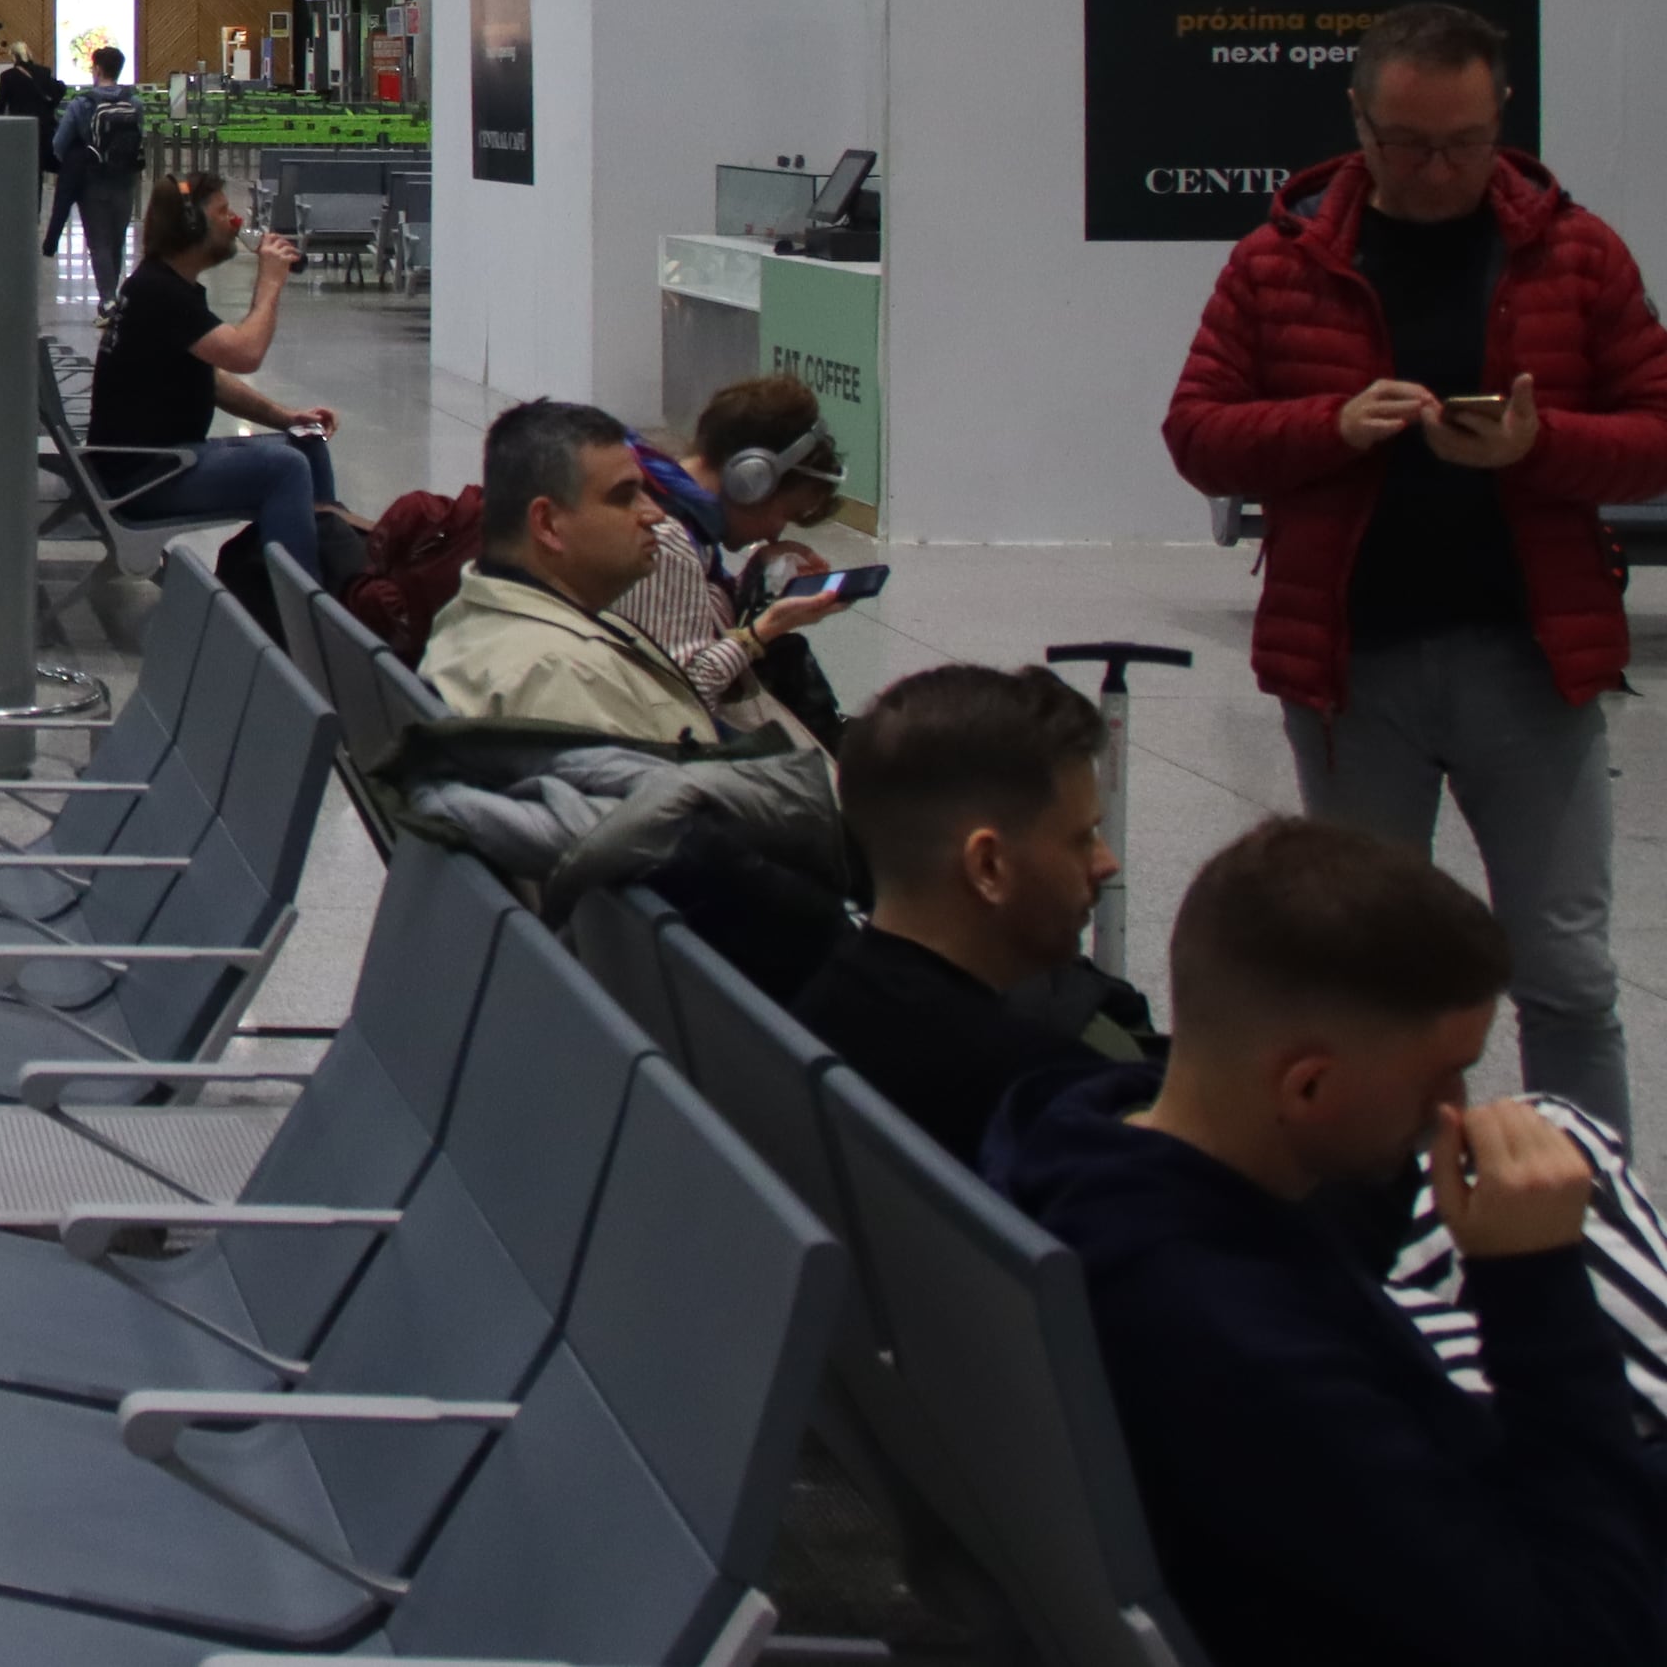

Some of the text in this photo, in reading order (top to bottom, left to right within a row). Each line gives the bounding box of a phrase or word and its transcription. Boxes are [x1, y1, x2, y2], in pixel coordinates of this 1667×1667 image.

[1177, 7, 1386, 37] próxima aper
[1212, 42, 1281, 63] next
[1145, 168, 1292, 194] CENTR
[805, 354, 861, 404] COFFEE
